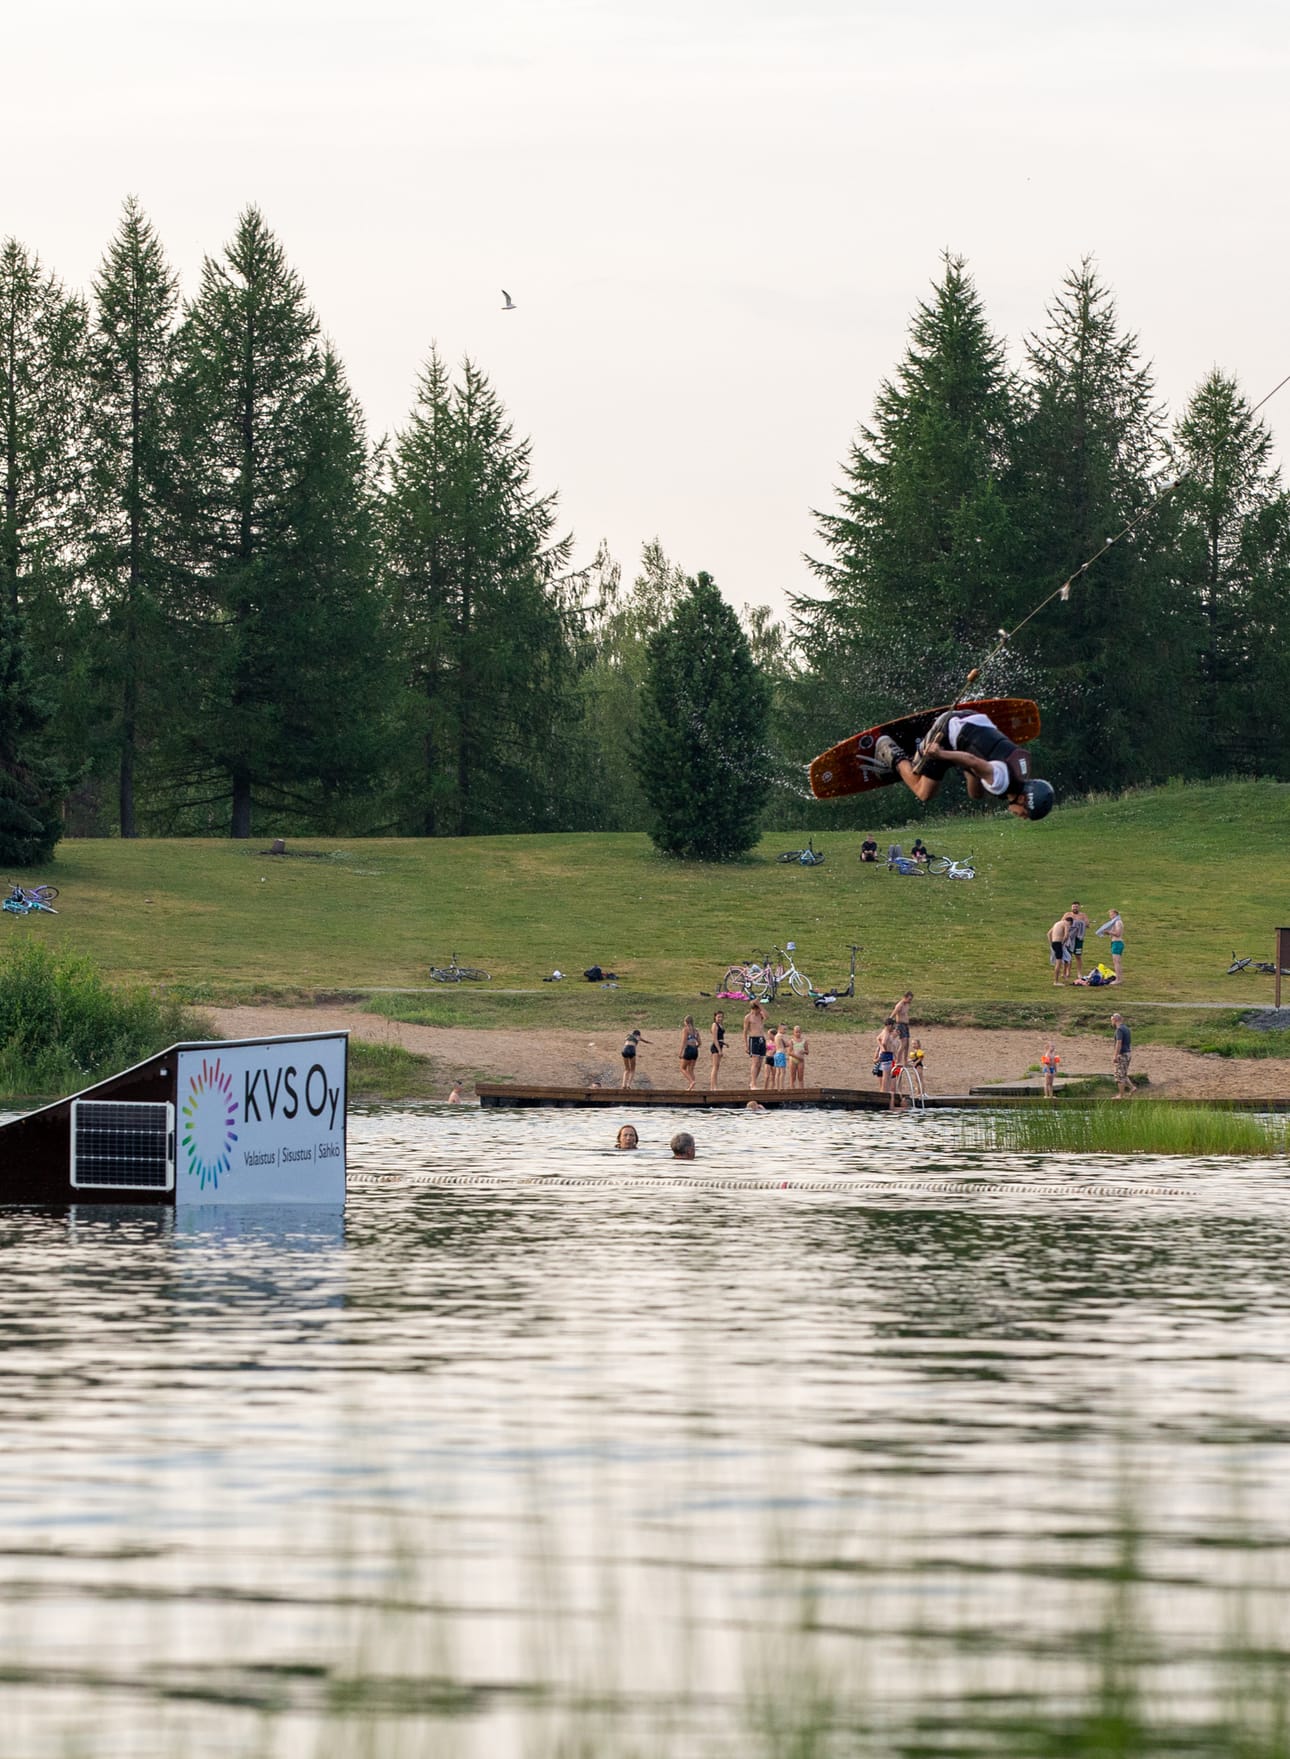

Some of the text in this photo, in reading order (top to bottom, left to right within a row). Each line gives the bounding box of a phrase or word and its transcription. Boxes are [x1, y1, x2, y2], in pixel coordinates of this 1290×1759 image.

[244, 1063, 340, 1131] KVS Oy
[244, 1141, 341, 1168] Valaistus Sisustus Sähkö
